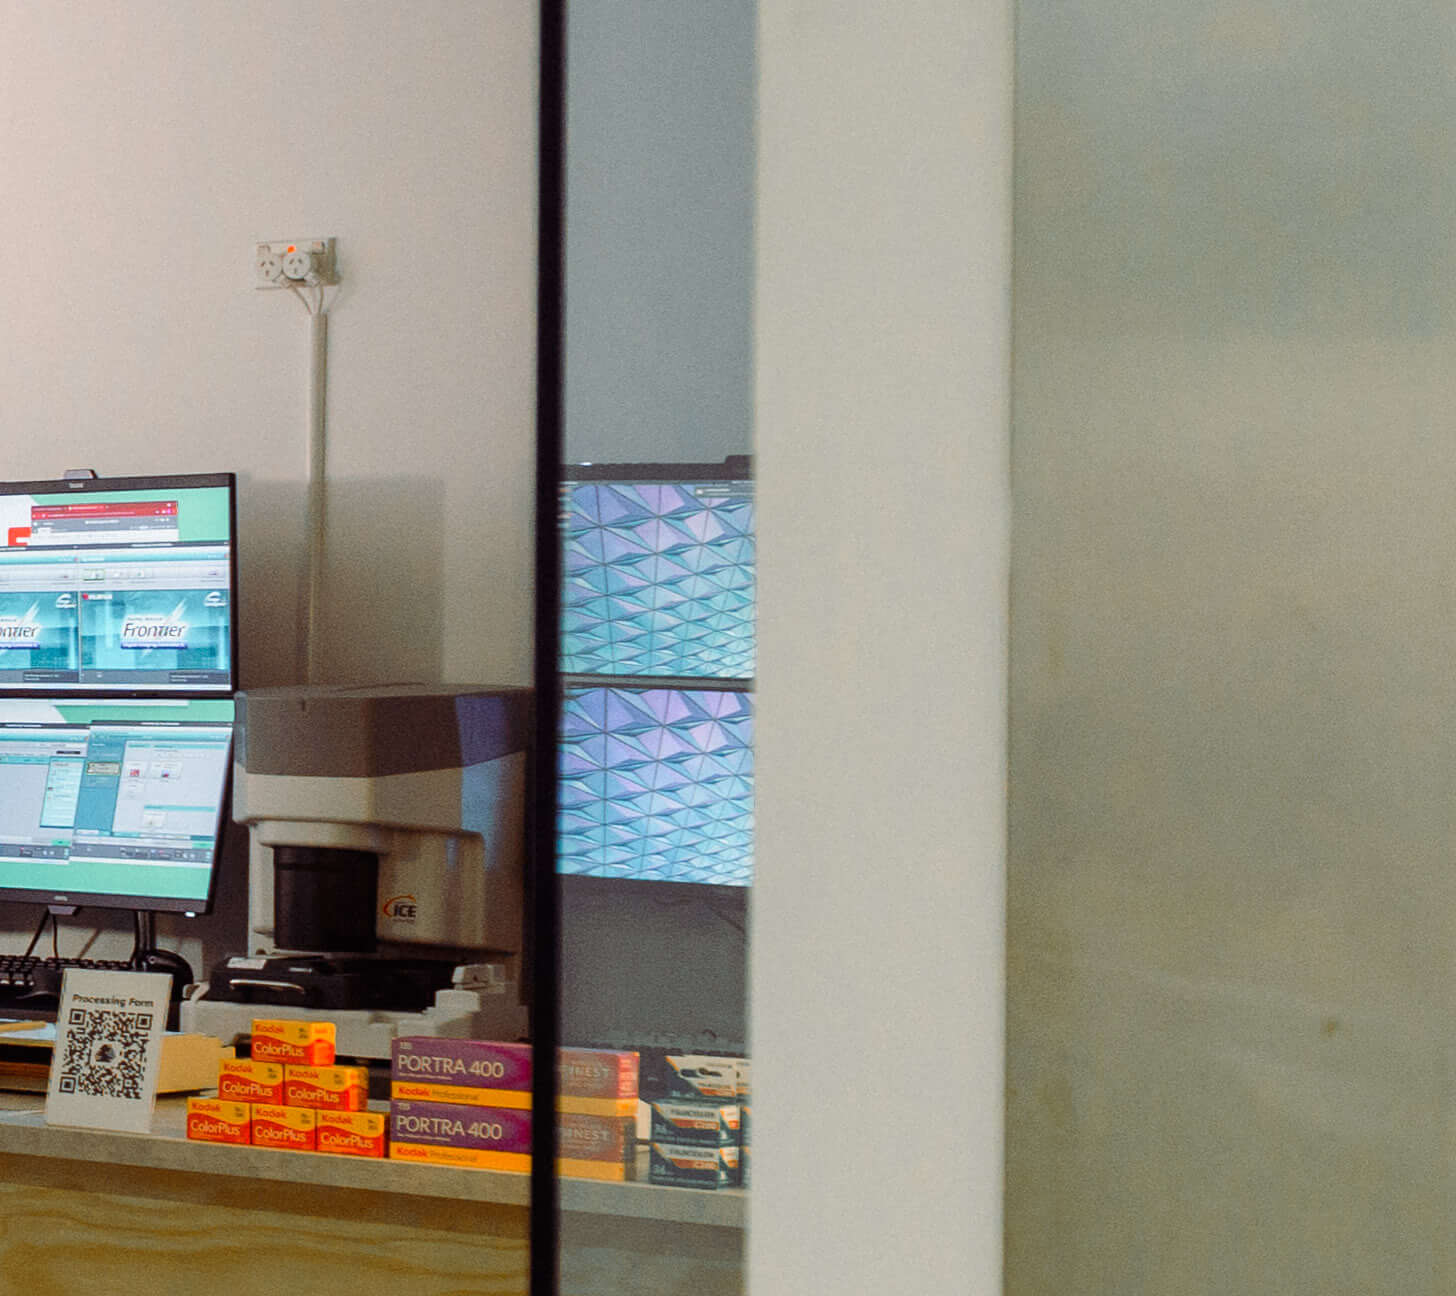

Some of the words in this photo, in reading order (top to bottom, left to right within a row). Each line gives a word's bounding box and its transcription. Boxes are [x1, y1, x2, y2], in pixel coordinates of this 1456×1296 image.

[123, 622, 187, 639] Frontier
[392, 903, 418, 918] ICE
[71, 993, 127, 1008] Processing
[129, 997, 154, 1008] Form
[254, 1023, 285, 1034] Kodak
[254, 1041, 305, 1058] ColorPlus
[223, 1063, 253, 1074] Kodak
[397, 1054, 467, 1075] PORTRA
[469, 1061, 505, 1079] 400
[288, 1069, 319, 1080] Kodak
[222, 1080, 273, 1097] ColorPlus
[288, 1086, 340, 1103] ColorPlus
[398, 1087, 431, 1098] Kodak
[191, 1102, 221, 1112] Kodak
[255, 1108, 286, 1119] Kodak
[321, 1114, 353, 1125] Kodak
[190, 1119, 241, 1136] ColorPlus
[255, 1126, 307, 1143] ColorPlus
[396, 1115, 466, 1136] PORTRA
[468, 1122, 503, 1140] 400
[320, 1132, 374, 1150] ColorPlus
[396, 1147, 428, 1158] Kodak
